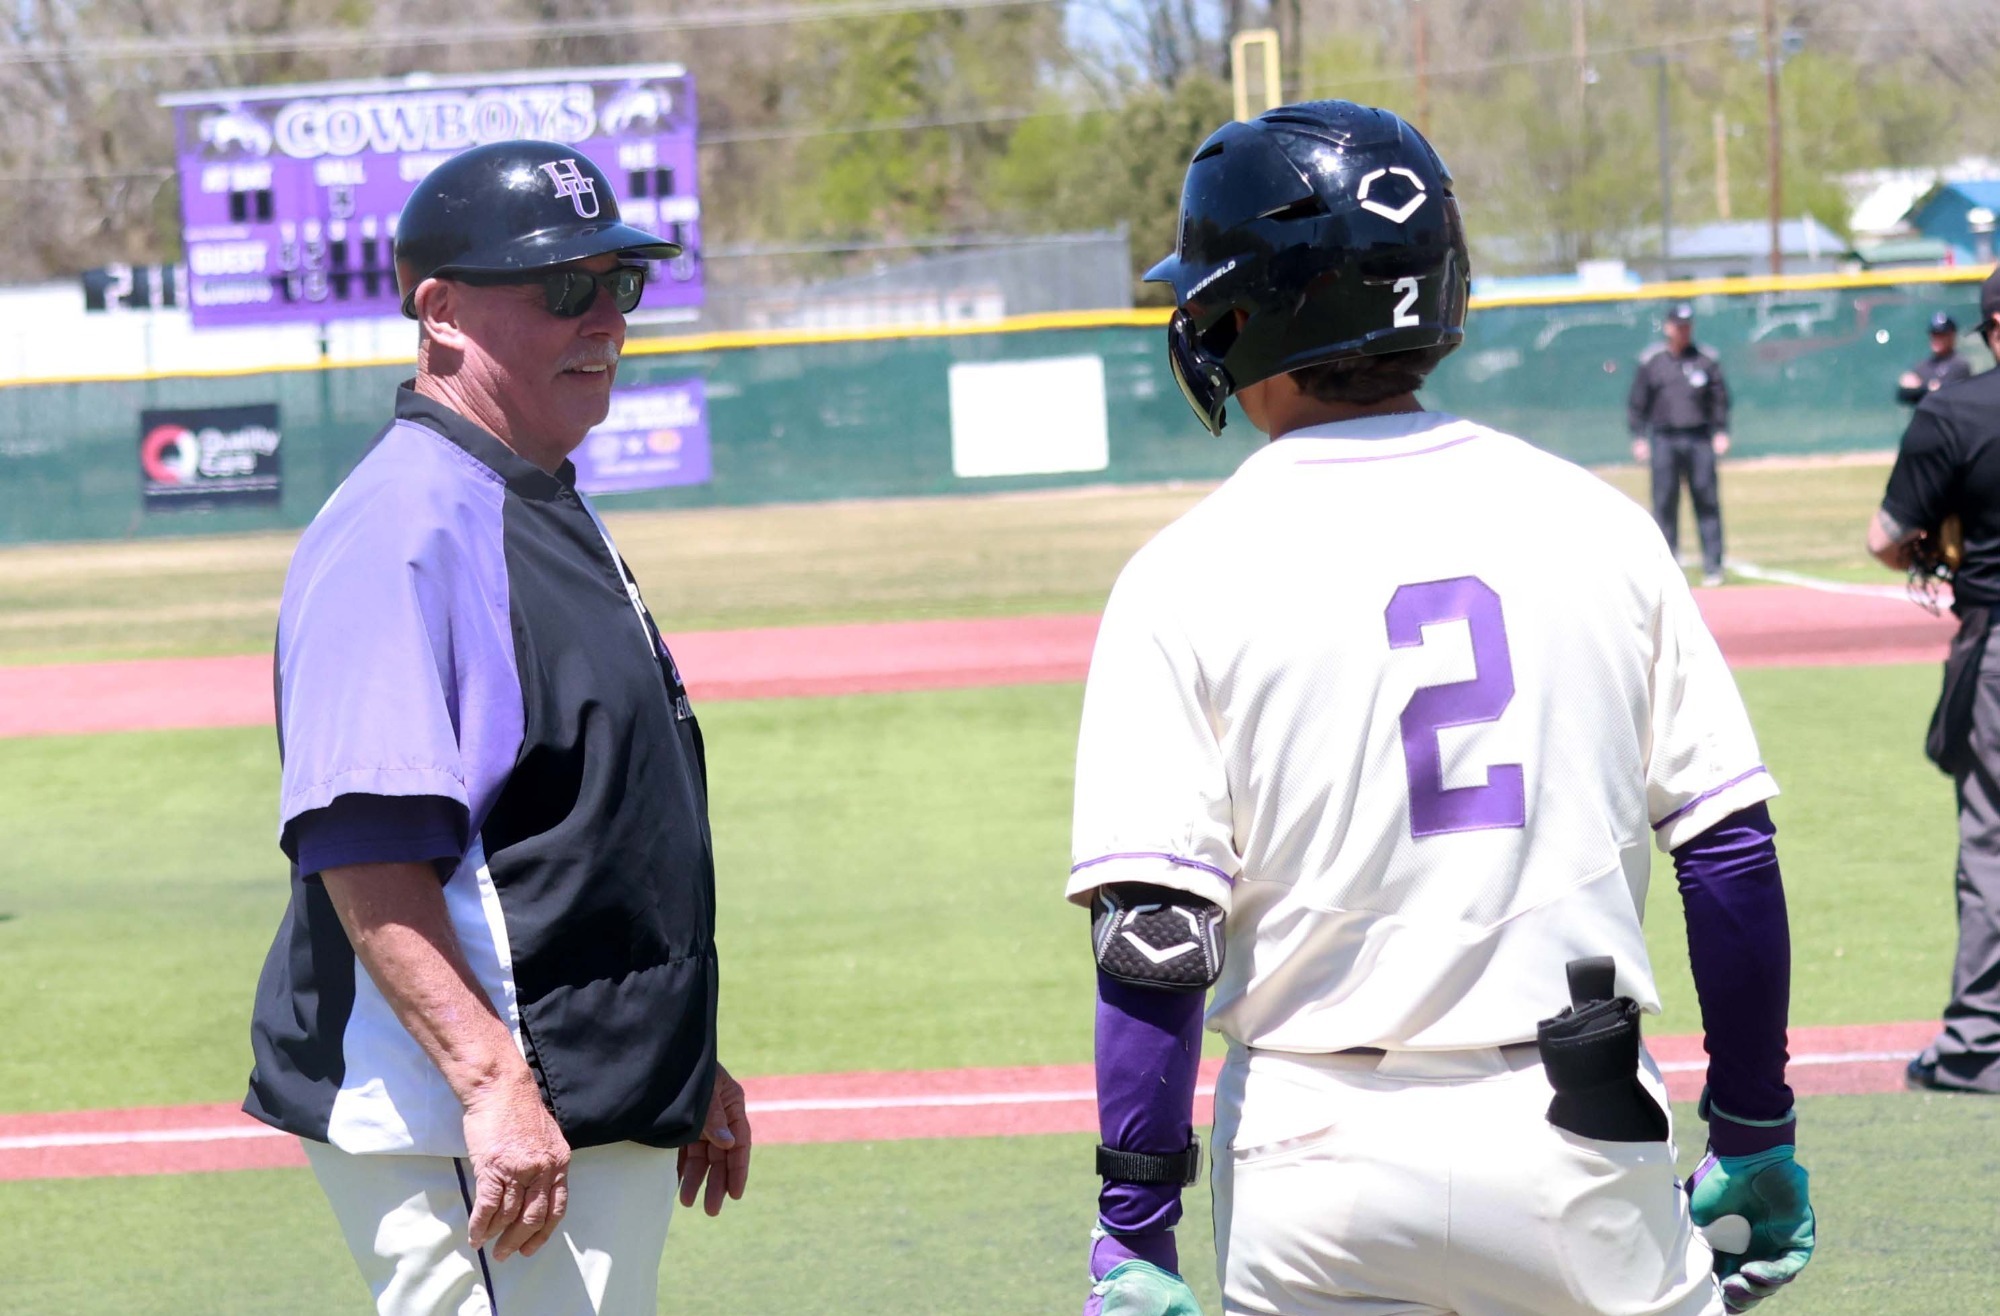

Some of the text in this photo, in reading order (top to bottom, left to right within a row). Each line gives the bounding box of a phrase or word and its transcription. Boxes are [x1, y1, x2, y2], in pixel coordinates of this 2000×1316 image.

[274, 80, 598, 160] COWBOYS
[1186, 260, 1236, 300] EVOSHIELD
[1393, 276, 1420, 329] 2
[1384, 575, 1525, 839] 2
